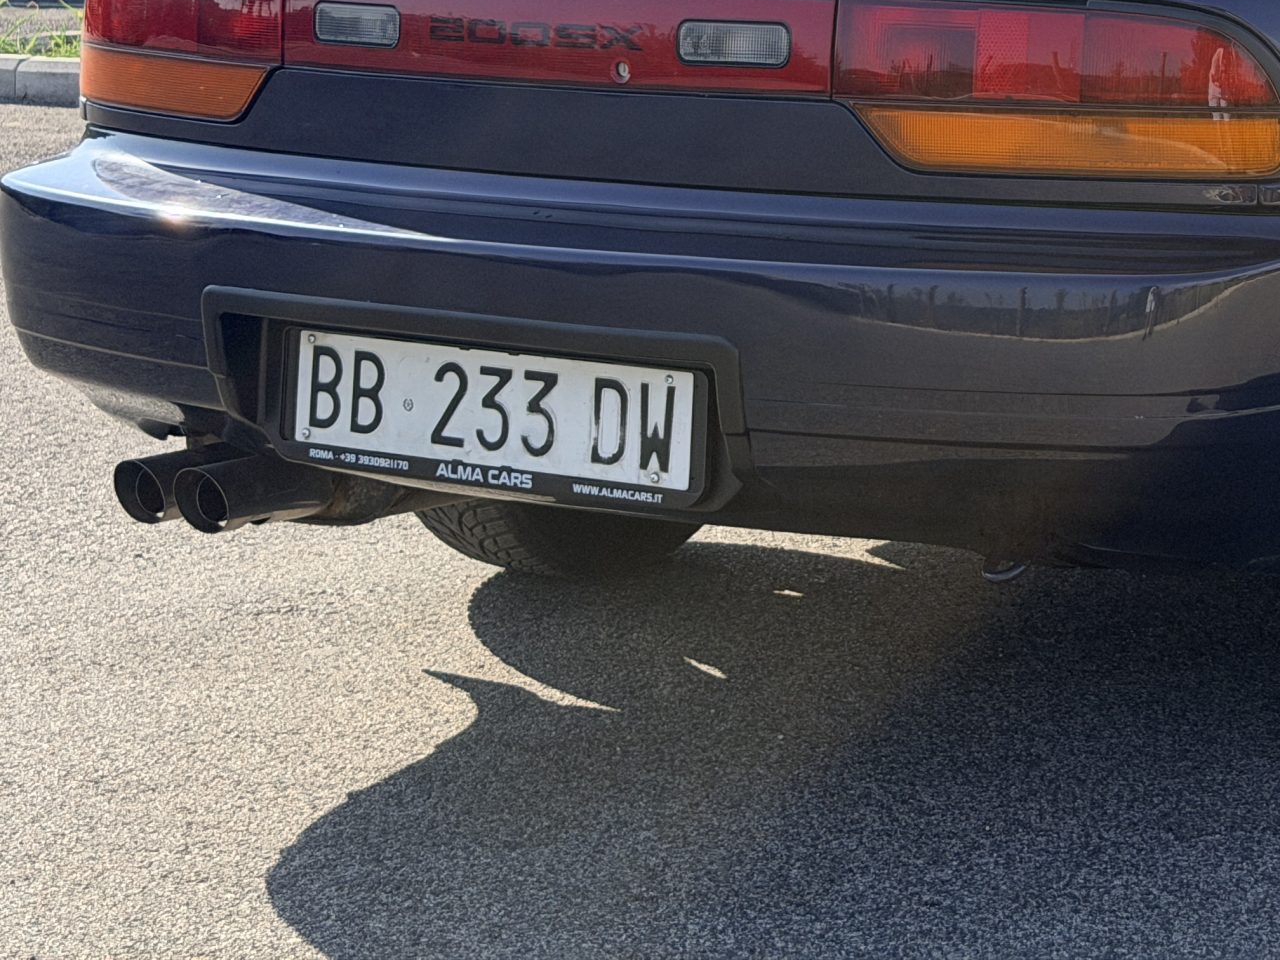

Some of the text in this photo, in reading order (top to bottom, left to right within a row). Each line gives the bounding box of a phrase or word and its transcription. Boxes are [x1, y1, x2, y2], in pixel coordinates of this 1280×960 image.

[429, 16, 644, 51] 200SX
[308, 344, 676, 474] BB 233 DW
[309, 447, 334, 461] ROMA
[340, 452, 357, 463] +39
[435, 462, 534, 489] ALMA CARS
[573, 483, 664, 504] WWW.ALMACARS.IT
